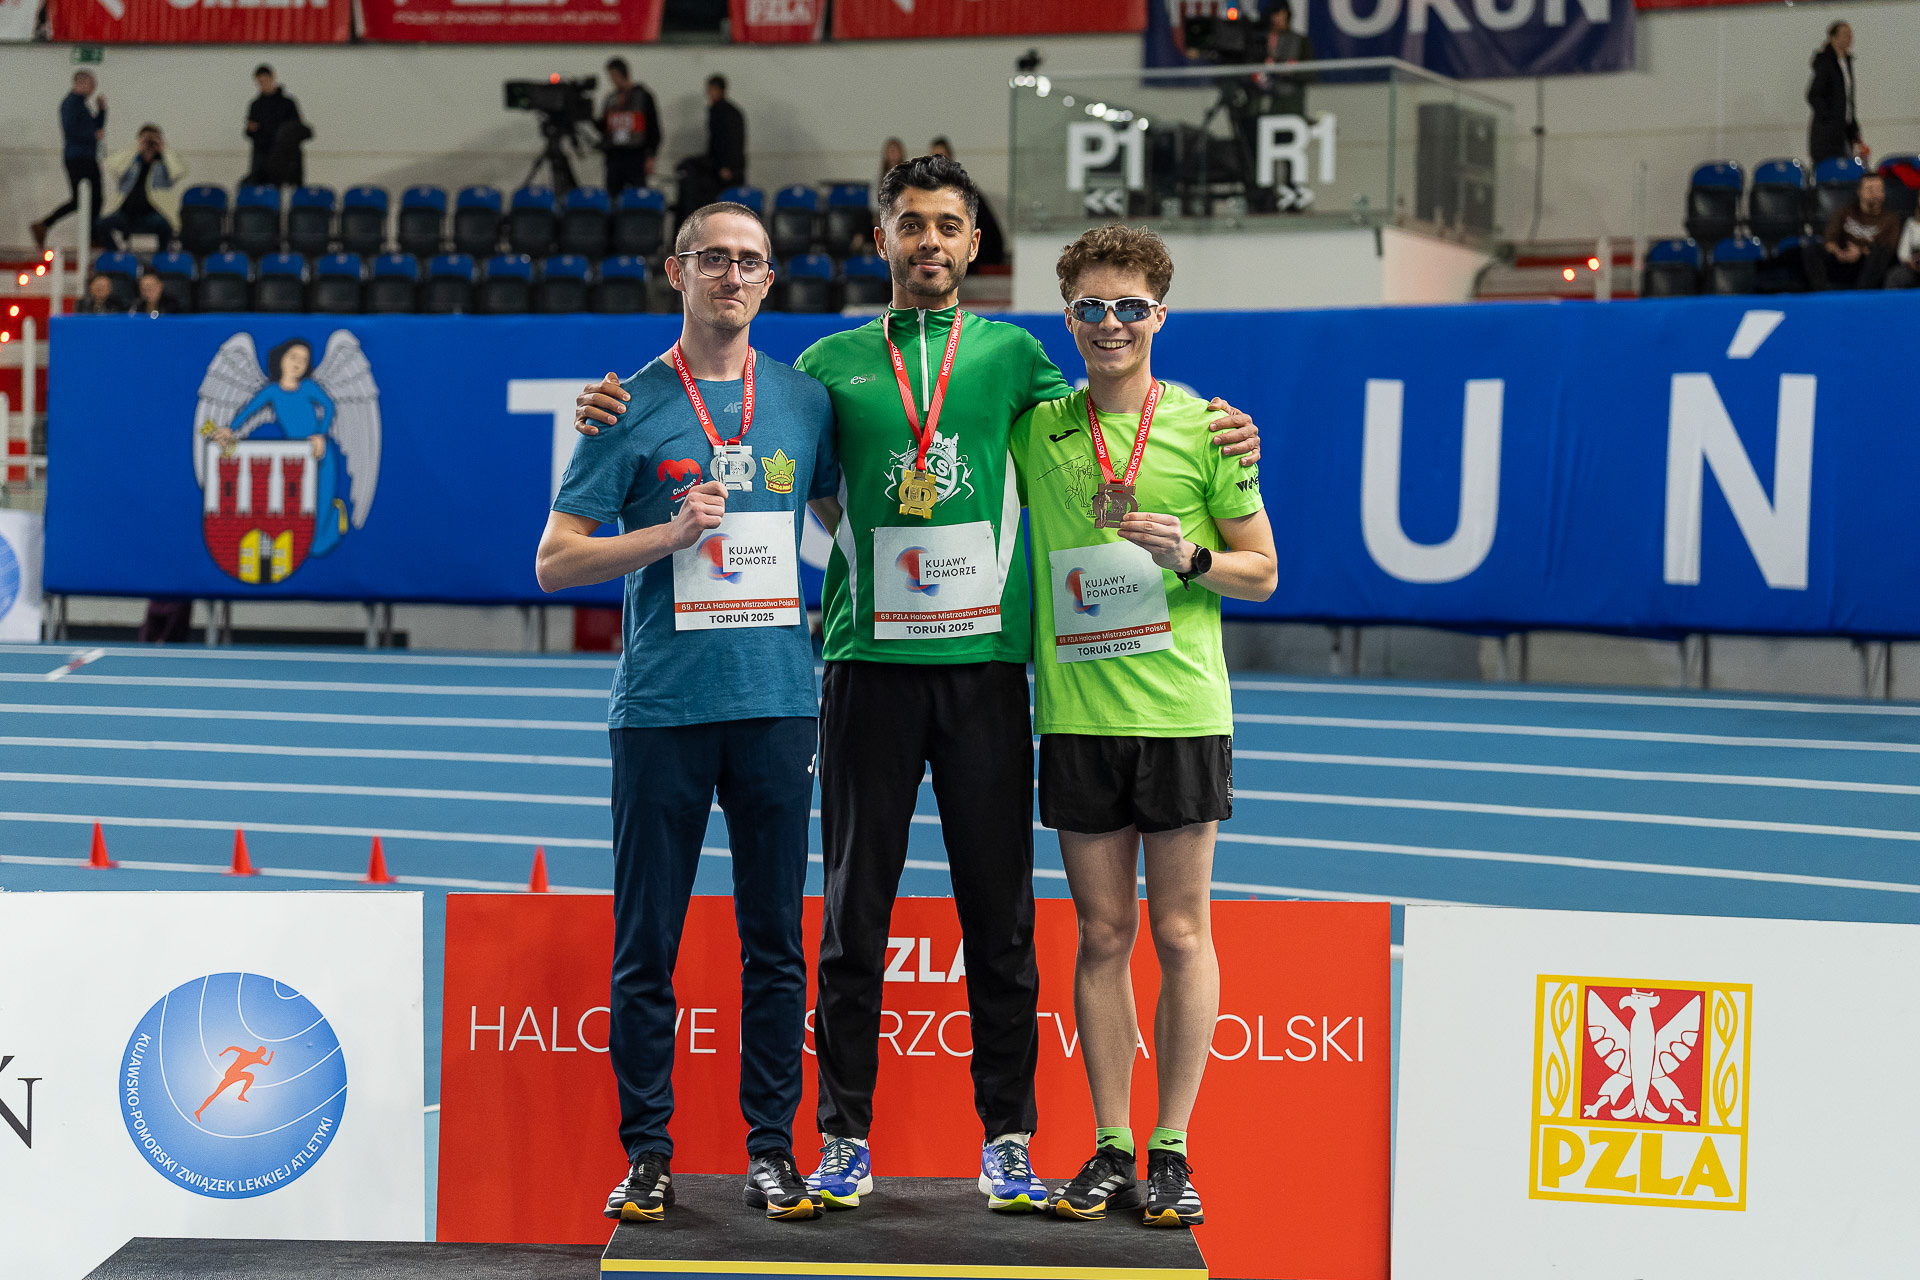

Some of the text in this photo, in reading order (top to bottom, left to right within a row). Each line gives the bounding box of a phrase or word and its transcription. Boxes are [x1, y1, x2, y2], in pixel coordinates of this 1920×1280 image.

[1067, 119, 1145, 190] P1
[1257, 114, 1337, 186] R1
[681, 369, 710, 425] MISTRZOSTWA
[744, 397, 753, 424] POLSKI
[1137, 388, 1157, 442] MISTRZOSTWA
[1130, 442, 1143, 470] POLSKI
[729, 546, 768, 555] KUJAWY
[729, 556, 777, 565] POMORZE
[925, 557, 967, 568] KUJAWY
[926, 566, 977, 578] POMORZE
[1085, 575, 1126, 588] KUJAWY
[1086, 584, 1139, 599] POMORZE
[709, 611, 775, 624] TORUŃ 2025
[938, 610, 978, 619] Mistrzostwa
[978, 607, 997, 615] Polski
[906, 622, 974, 634] TORUŃ 2025
[1077, 640, 1141, 657] TORUŃ 2025
[884, 937, 966, 982] ZLA
[469, 1005, 717, 1054] HALOE
[1209, 1014, 1364, 1063] OLSKI
[126, 1032, 333, 1192] KUJAWSKO-POMORSKI ZWIĄZEK LEKKIEJ ATLETYKI
[1540, 1127, 1733, 1198] PZLA
